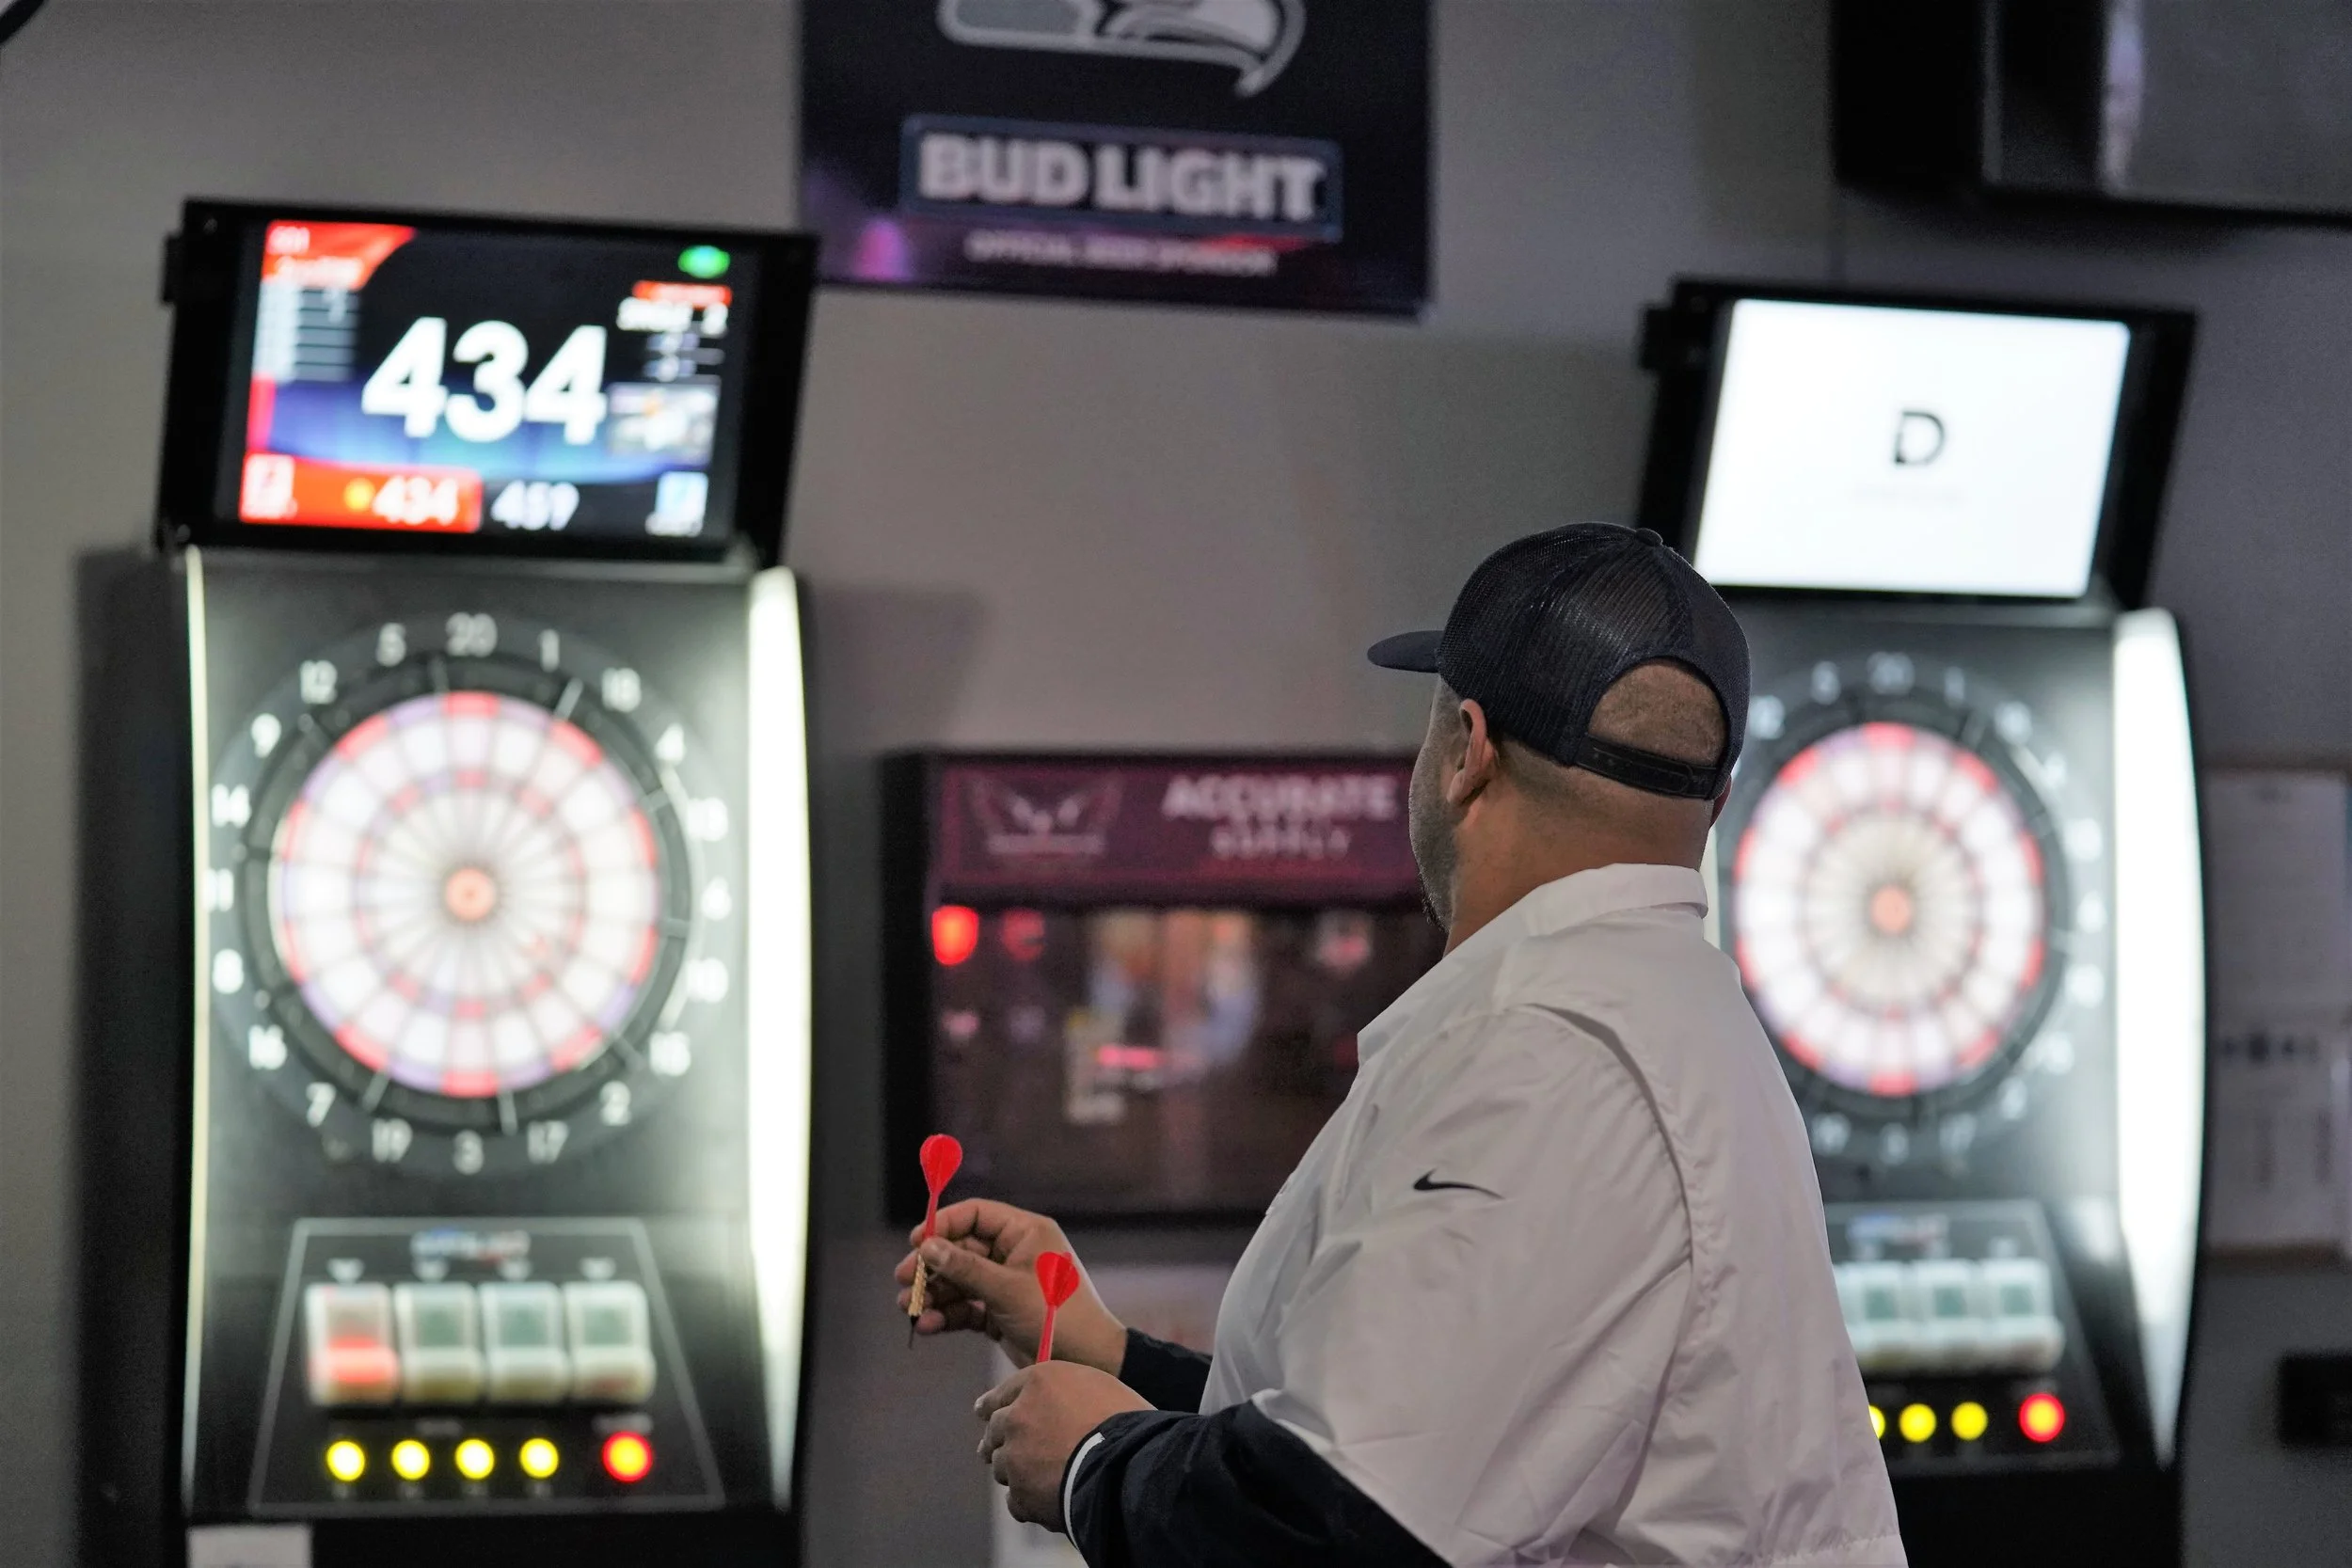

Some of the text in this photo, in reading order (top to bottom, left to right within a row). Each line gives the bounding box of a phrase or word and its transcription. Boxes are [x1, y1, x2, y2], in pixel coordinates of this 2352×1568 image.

[917, 133, 1327, 222] BUD LIGHT
[361, 316, 608, 445] 434
[1892, 408, 1947, 467] D
[373, 474, 458, 527] 434
[378, 623, 405, 666] 5
[446, 612, 498, 657] 20
[539, 629, 560, 672] 1
[300, 660, 338, 704] 12
[251, 714, 281, 756] 9
[658, 723, 684, 766] 4
[211, 784, 250, 827] 14
[1162, 775, 1398, 820] ACCURATE
[306, 1082, 336, 1126] 7
[453, 1130, 484, 1174] 3
